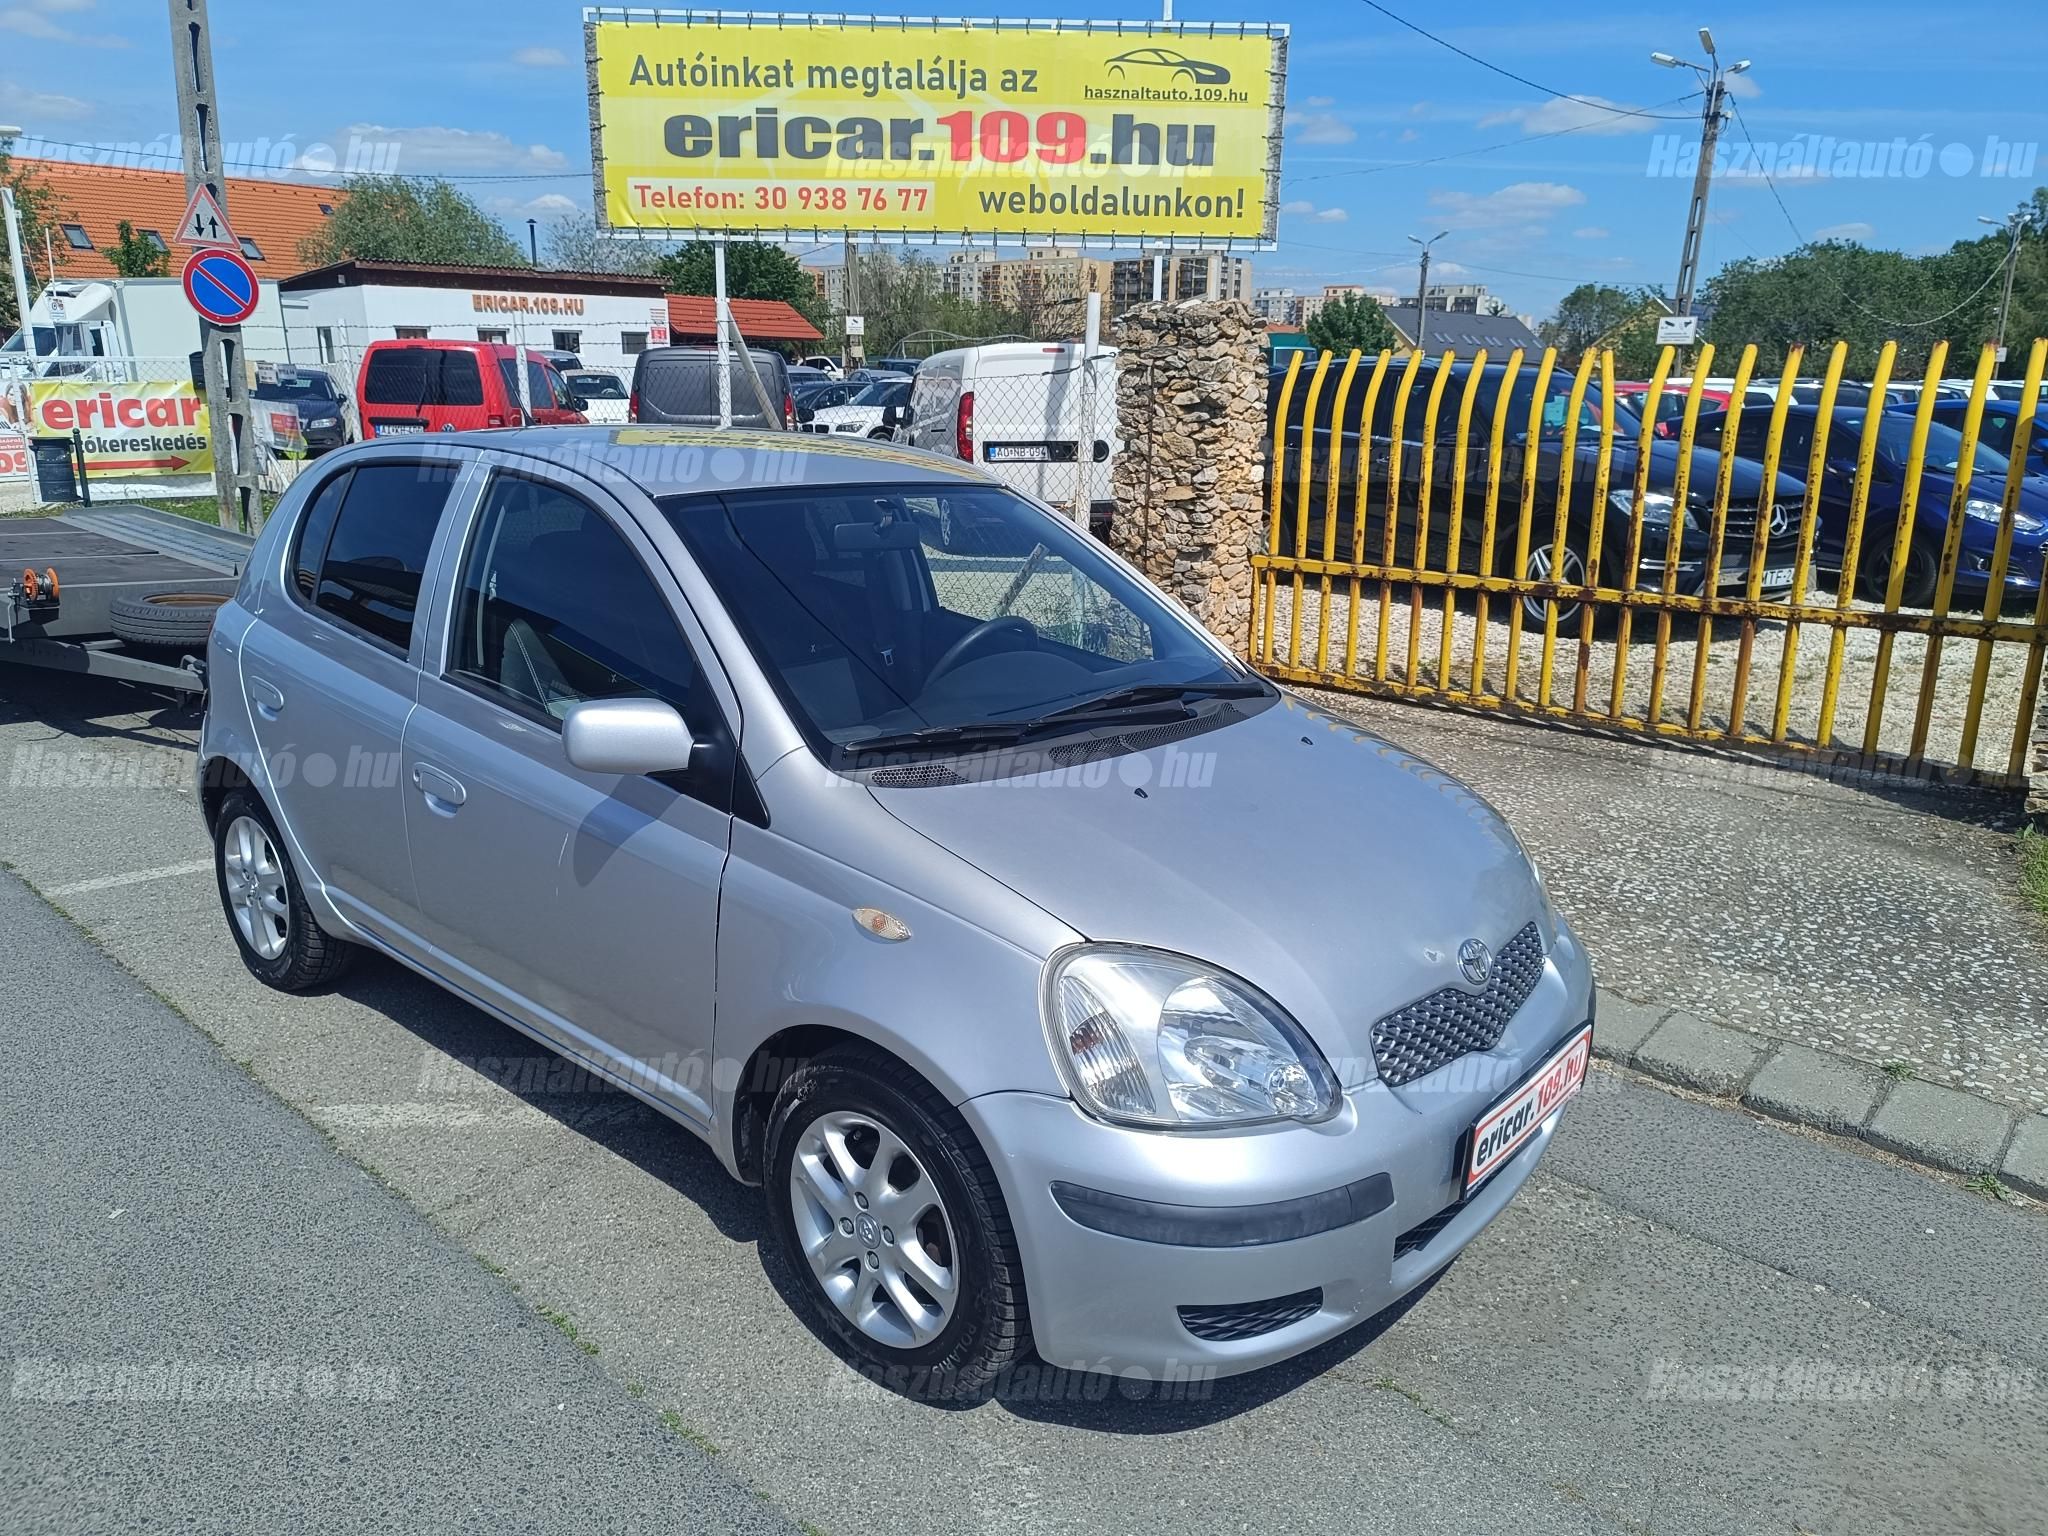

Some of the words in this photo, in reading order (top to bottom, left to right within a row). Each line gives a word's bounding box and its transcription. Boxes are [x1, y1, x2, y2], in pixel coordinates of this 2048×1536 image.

[629, 51, 794, 88] Autóinkat
[807, 55, 987, 100] megtalálja
[1000, 68, 1038, 93] az
[1084, 85, 1248, 103] hasznaltauto.109.hu
[663, 106, 1216, 168] ericar.109.hu
[634, 185, 745, 210] Telefon:
[755, 186, 787, 210] 30
[798, 187, 847, 210] 938
[857, 188, 888, 211] 76
[898, 188, 928, 212] 77
[979, 183, 1245, 218] weboldalunkon!
[472, 294, 584, 317] ERICAR.109.HU
[42, 392, 201, 430] ericar
[79, 433, 207, 454] ókereskedés
